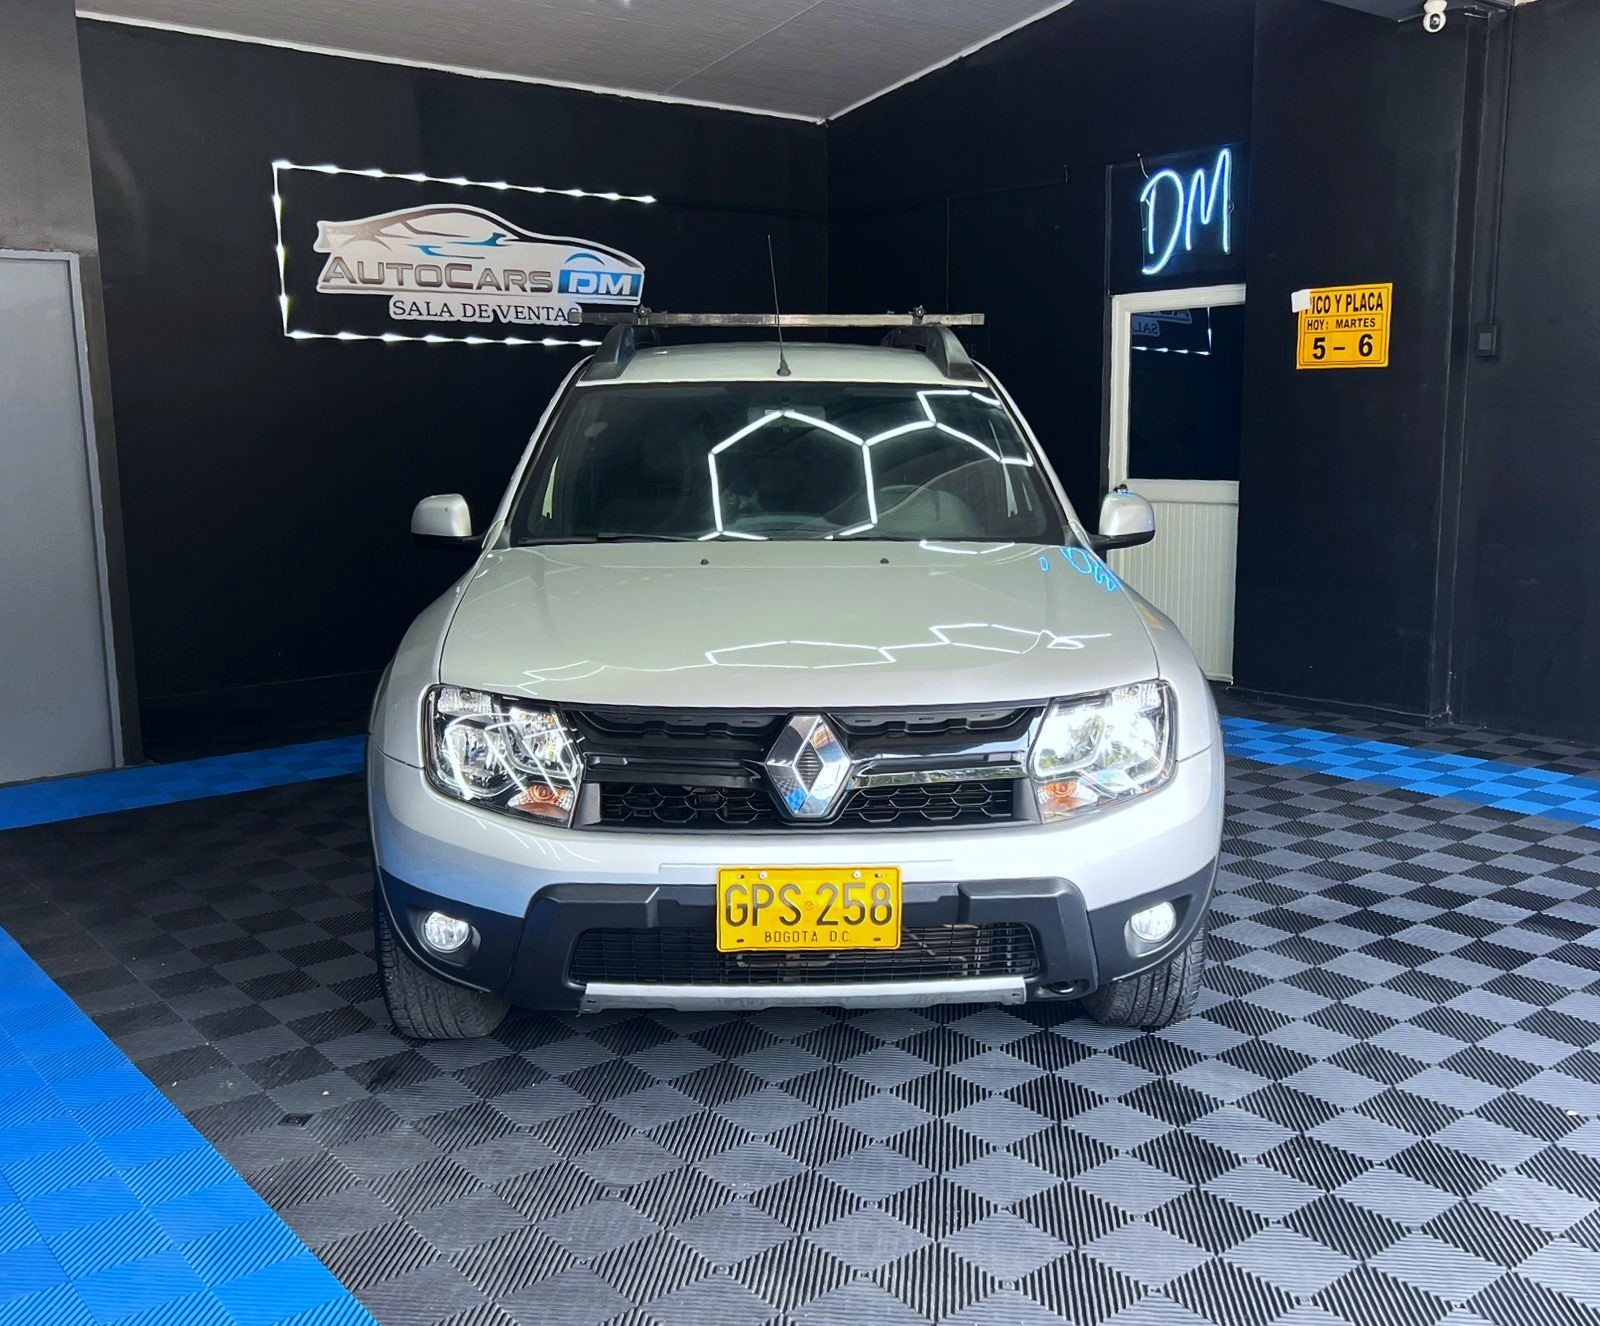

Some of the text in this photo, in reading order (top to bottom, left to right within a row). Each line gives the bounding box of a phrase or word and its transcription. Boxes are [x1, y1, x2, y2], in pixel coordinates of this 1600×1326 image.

[1140, 149, 1231, 274] DM
[568, 273, 632, 296] DM
[393, 300, 454, 318] SALA
[462, 303, 490, 319] DE
[1334, 295, 1342, 312] Y
[1346, 292, 1383, 312] PLACA
[1307, 318, 1376, 330] HOY: MARTES
[1312, 337, 1326, 359] 5
[1359, 333, 1373, 357] 6
[725, 882, 893, 926] GPS 258
[765, 931, 818, 943] BOGOTA
